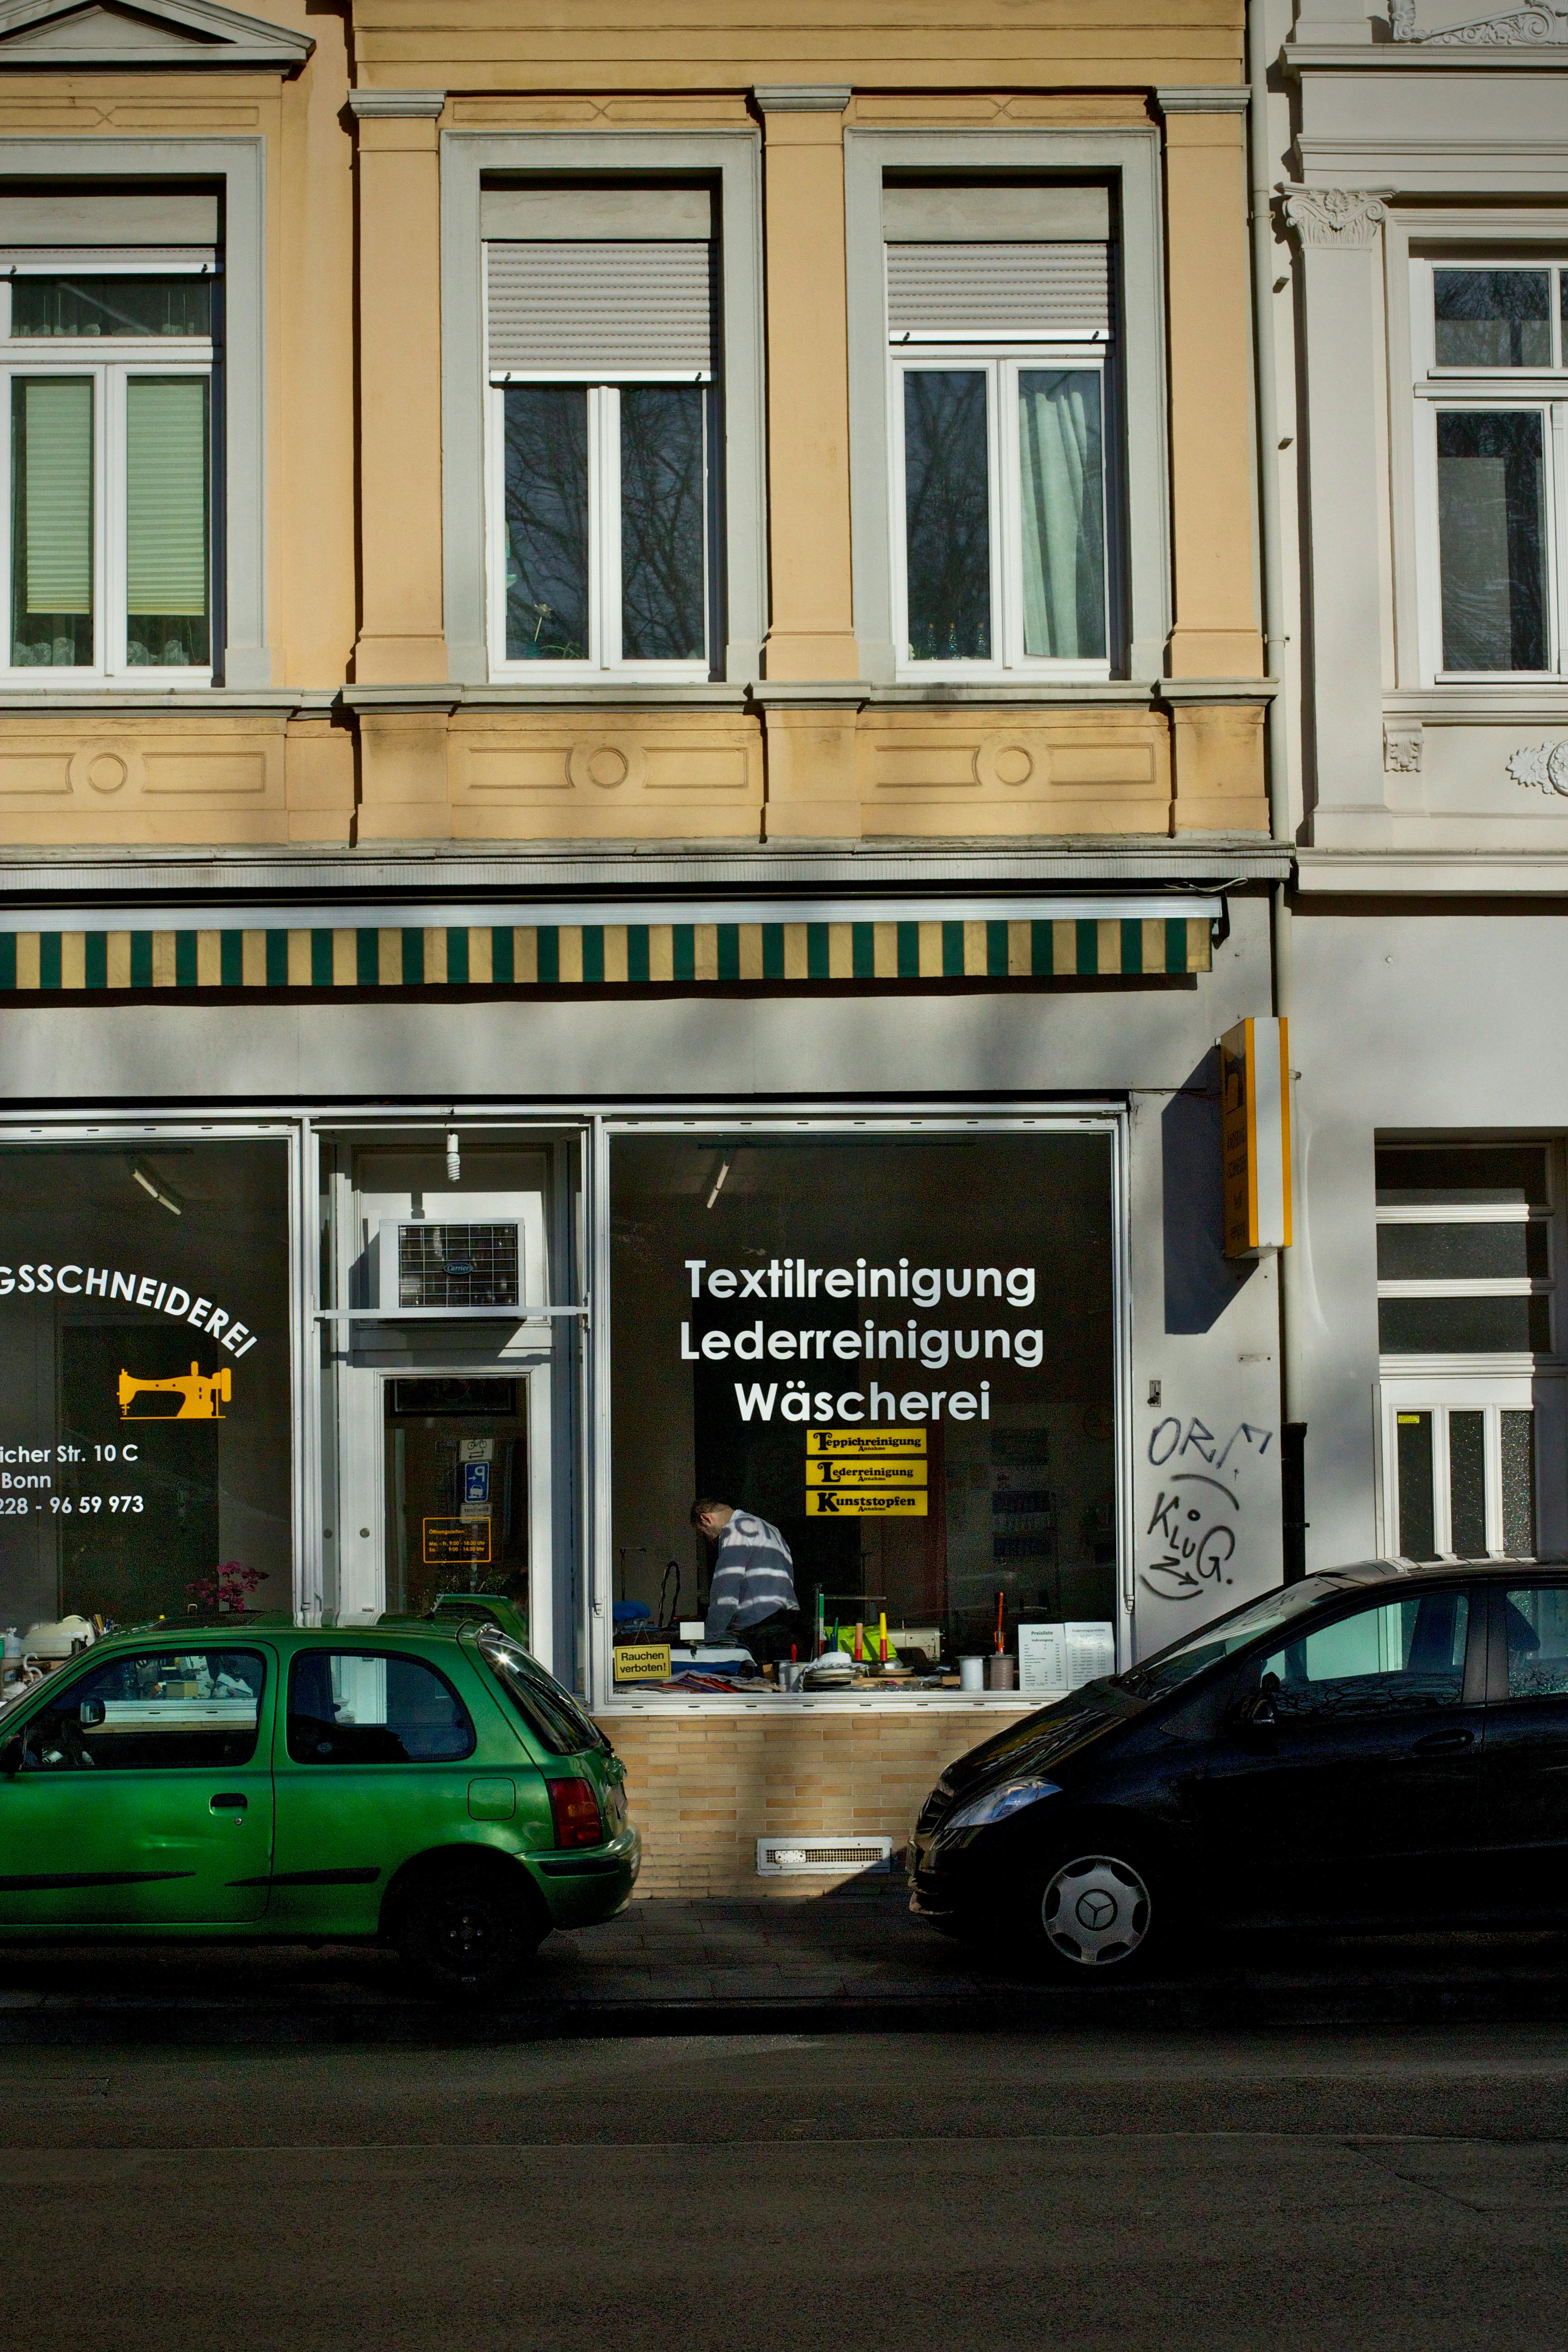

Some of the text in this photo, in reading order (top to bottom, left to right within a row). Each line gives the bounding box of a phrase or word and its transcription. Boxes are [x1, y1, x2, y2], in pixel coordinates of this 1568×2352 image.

[685, 1258, 1035, 1307] Textilreinigung
[681, 1320, 1043, 1368] Lederreinigung
[734, 1381, 990, 1421] Wäscherei
[813, 1432, 921, 1451] Teppichreinigung
[57, 1445, 86, 1462] Str.
[94, 1445, 116, 1461] 10
[122, 1444, 138, 1461] C
[2, 1472, 51, 1489] Bonn
[817, 1462, 914, 1482] Lederreinigung
[50, 1497, 72, 1514] 96
[79, 1496, 102, 1513] 59
[109, 1495, 144, 1513] 973
[817, 1492, 916, 1512] Kunststopfen
[621, 1651, 664, 1661] Rauchen
[620, 1662, 666, 1673] verboten!
